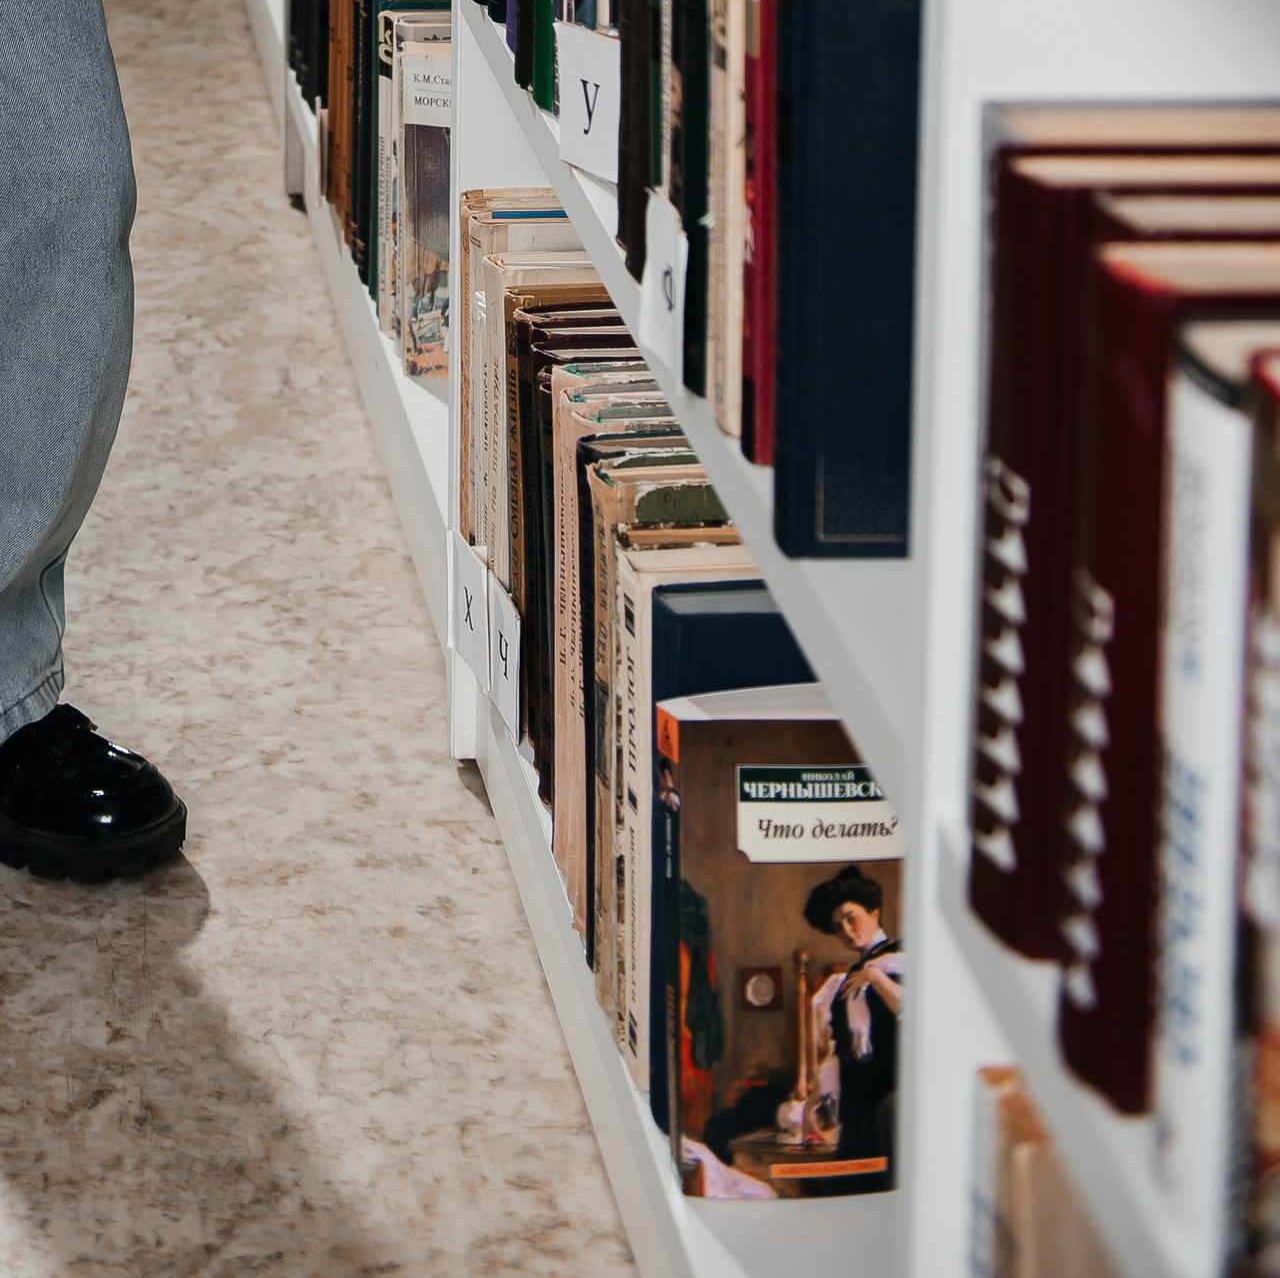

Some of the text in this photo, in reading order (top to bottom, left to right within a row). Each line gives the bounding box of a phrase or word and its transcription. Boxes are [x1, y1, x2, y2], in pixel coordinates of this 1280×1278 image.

[580, 78, 600, 135] У
[662, 266, 676, 311] Ф
[507, 369, 517, 443] ЖИЗНЬ
[491, 356, 500, 513] ПО ЛИТЕРАТУРЕ
[508, 448, 519, 540] СМЕЛАЯ
[463, 587, 475, 631] Х
[498, 631, 511, 681] Ч
[626, 646, 637, 774] ПРОЛОГ
[801, 770, 856, 782] НИКОЛАЙ
[758, 816, 900, 840] Что делать?
